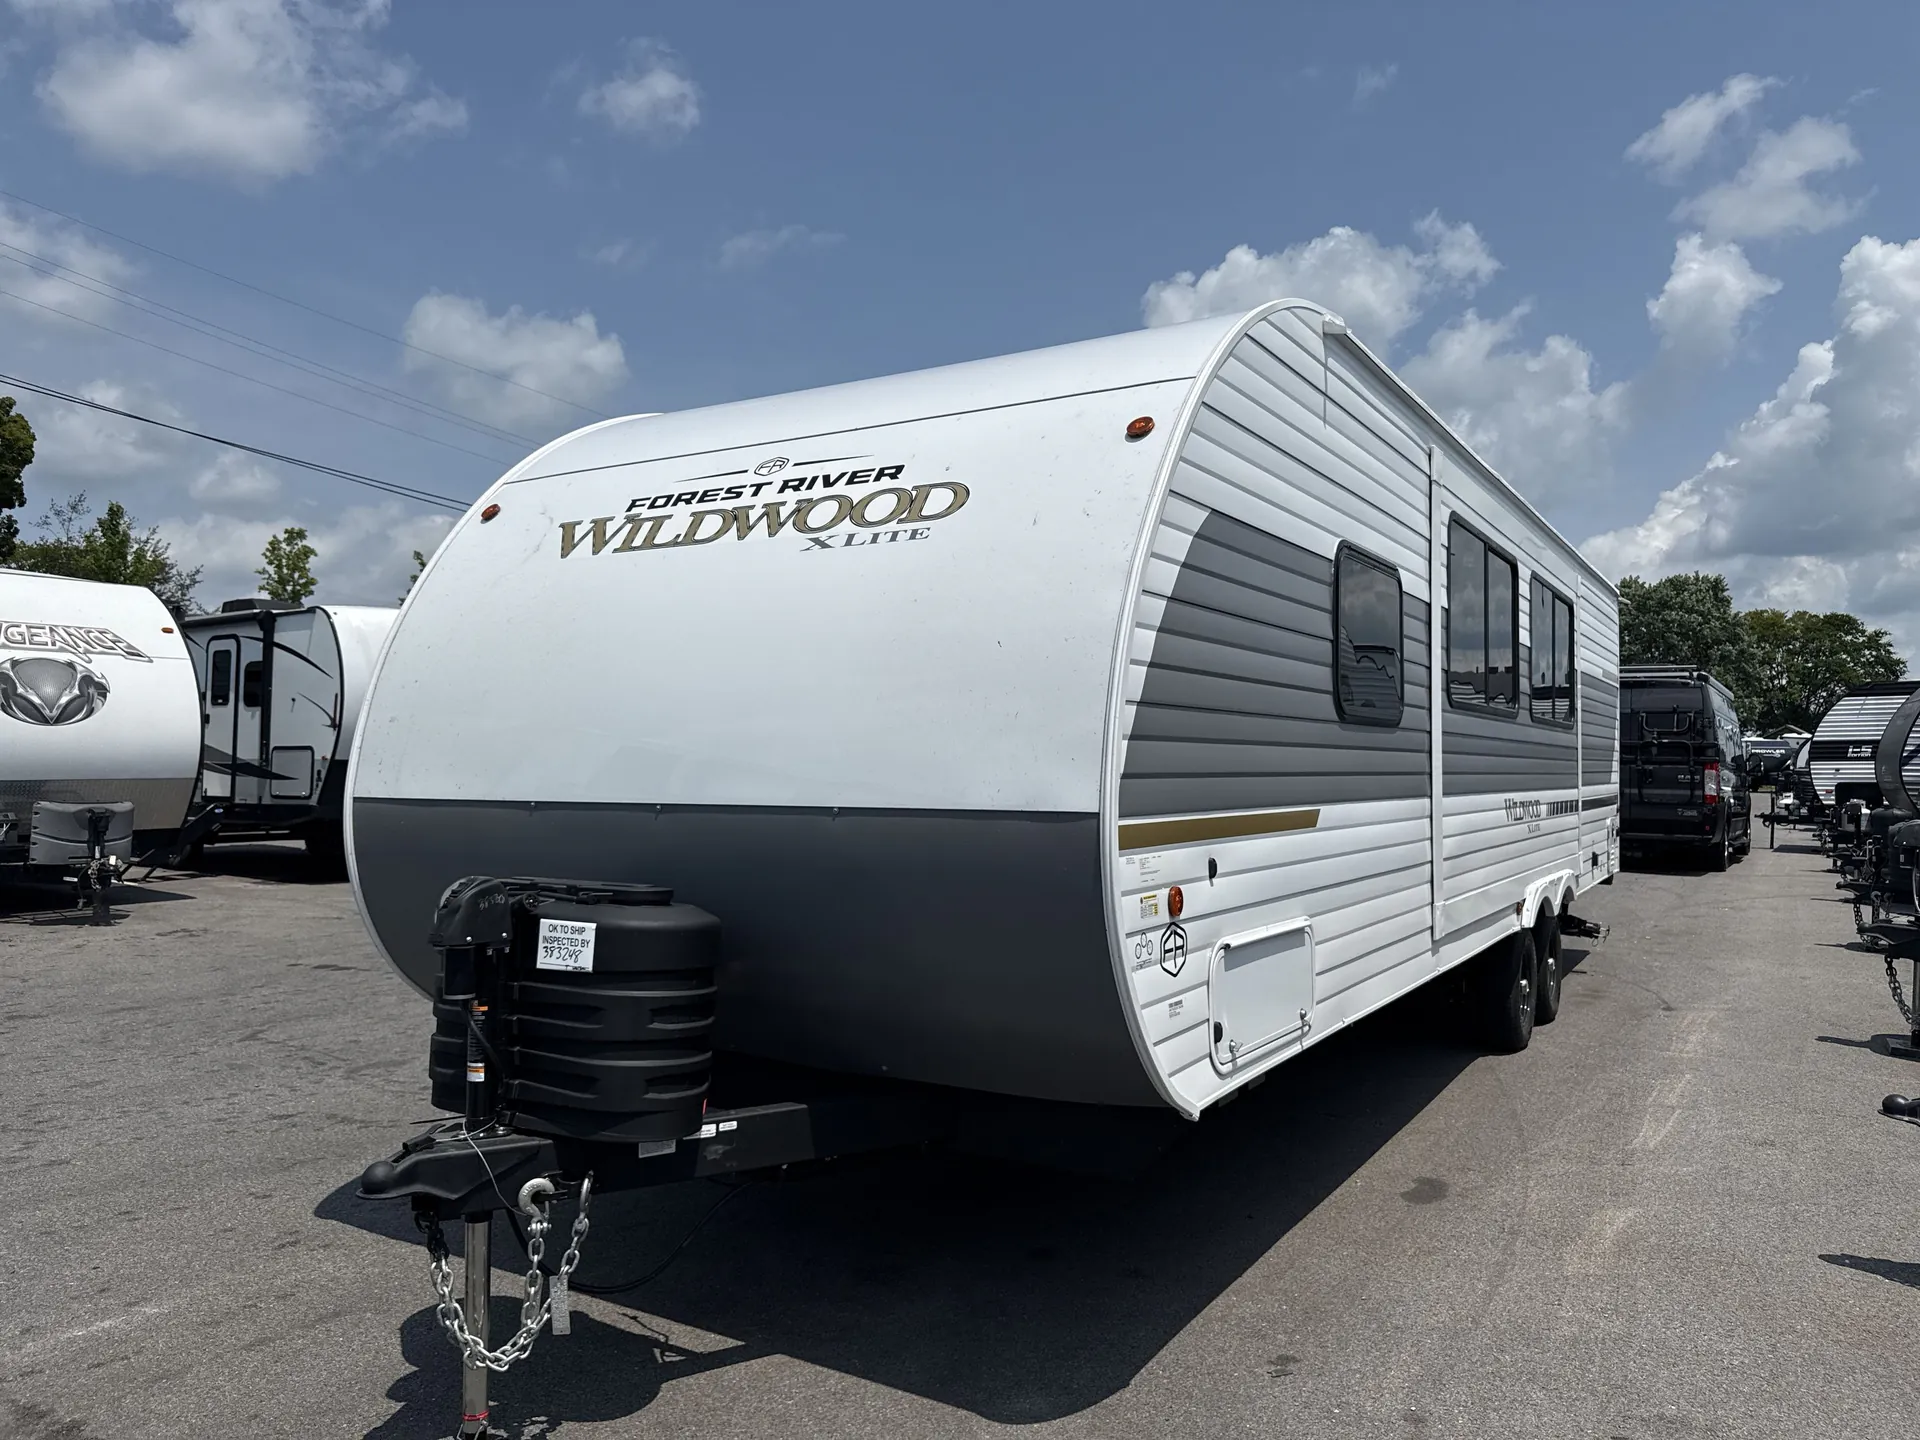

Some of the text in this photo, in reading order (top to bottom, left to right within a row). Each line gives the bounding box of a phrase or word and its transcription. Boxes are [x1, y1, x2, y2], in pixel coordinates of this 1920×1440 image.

[625, 464, 906, 513] FOREST RIVER
[558, 481, 971, 559] WILDWOOD
[0, 622, 149, 660] GEANCE
[1504, 798, 1541, 822] WILDWOOD
[542, 935, 591, 949] INSPECTED BY
[548, 923, 586, 936] OK TO SHIP
